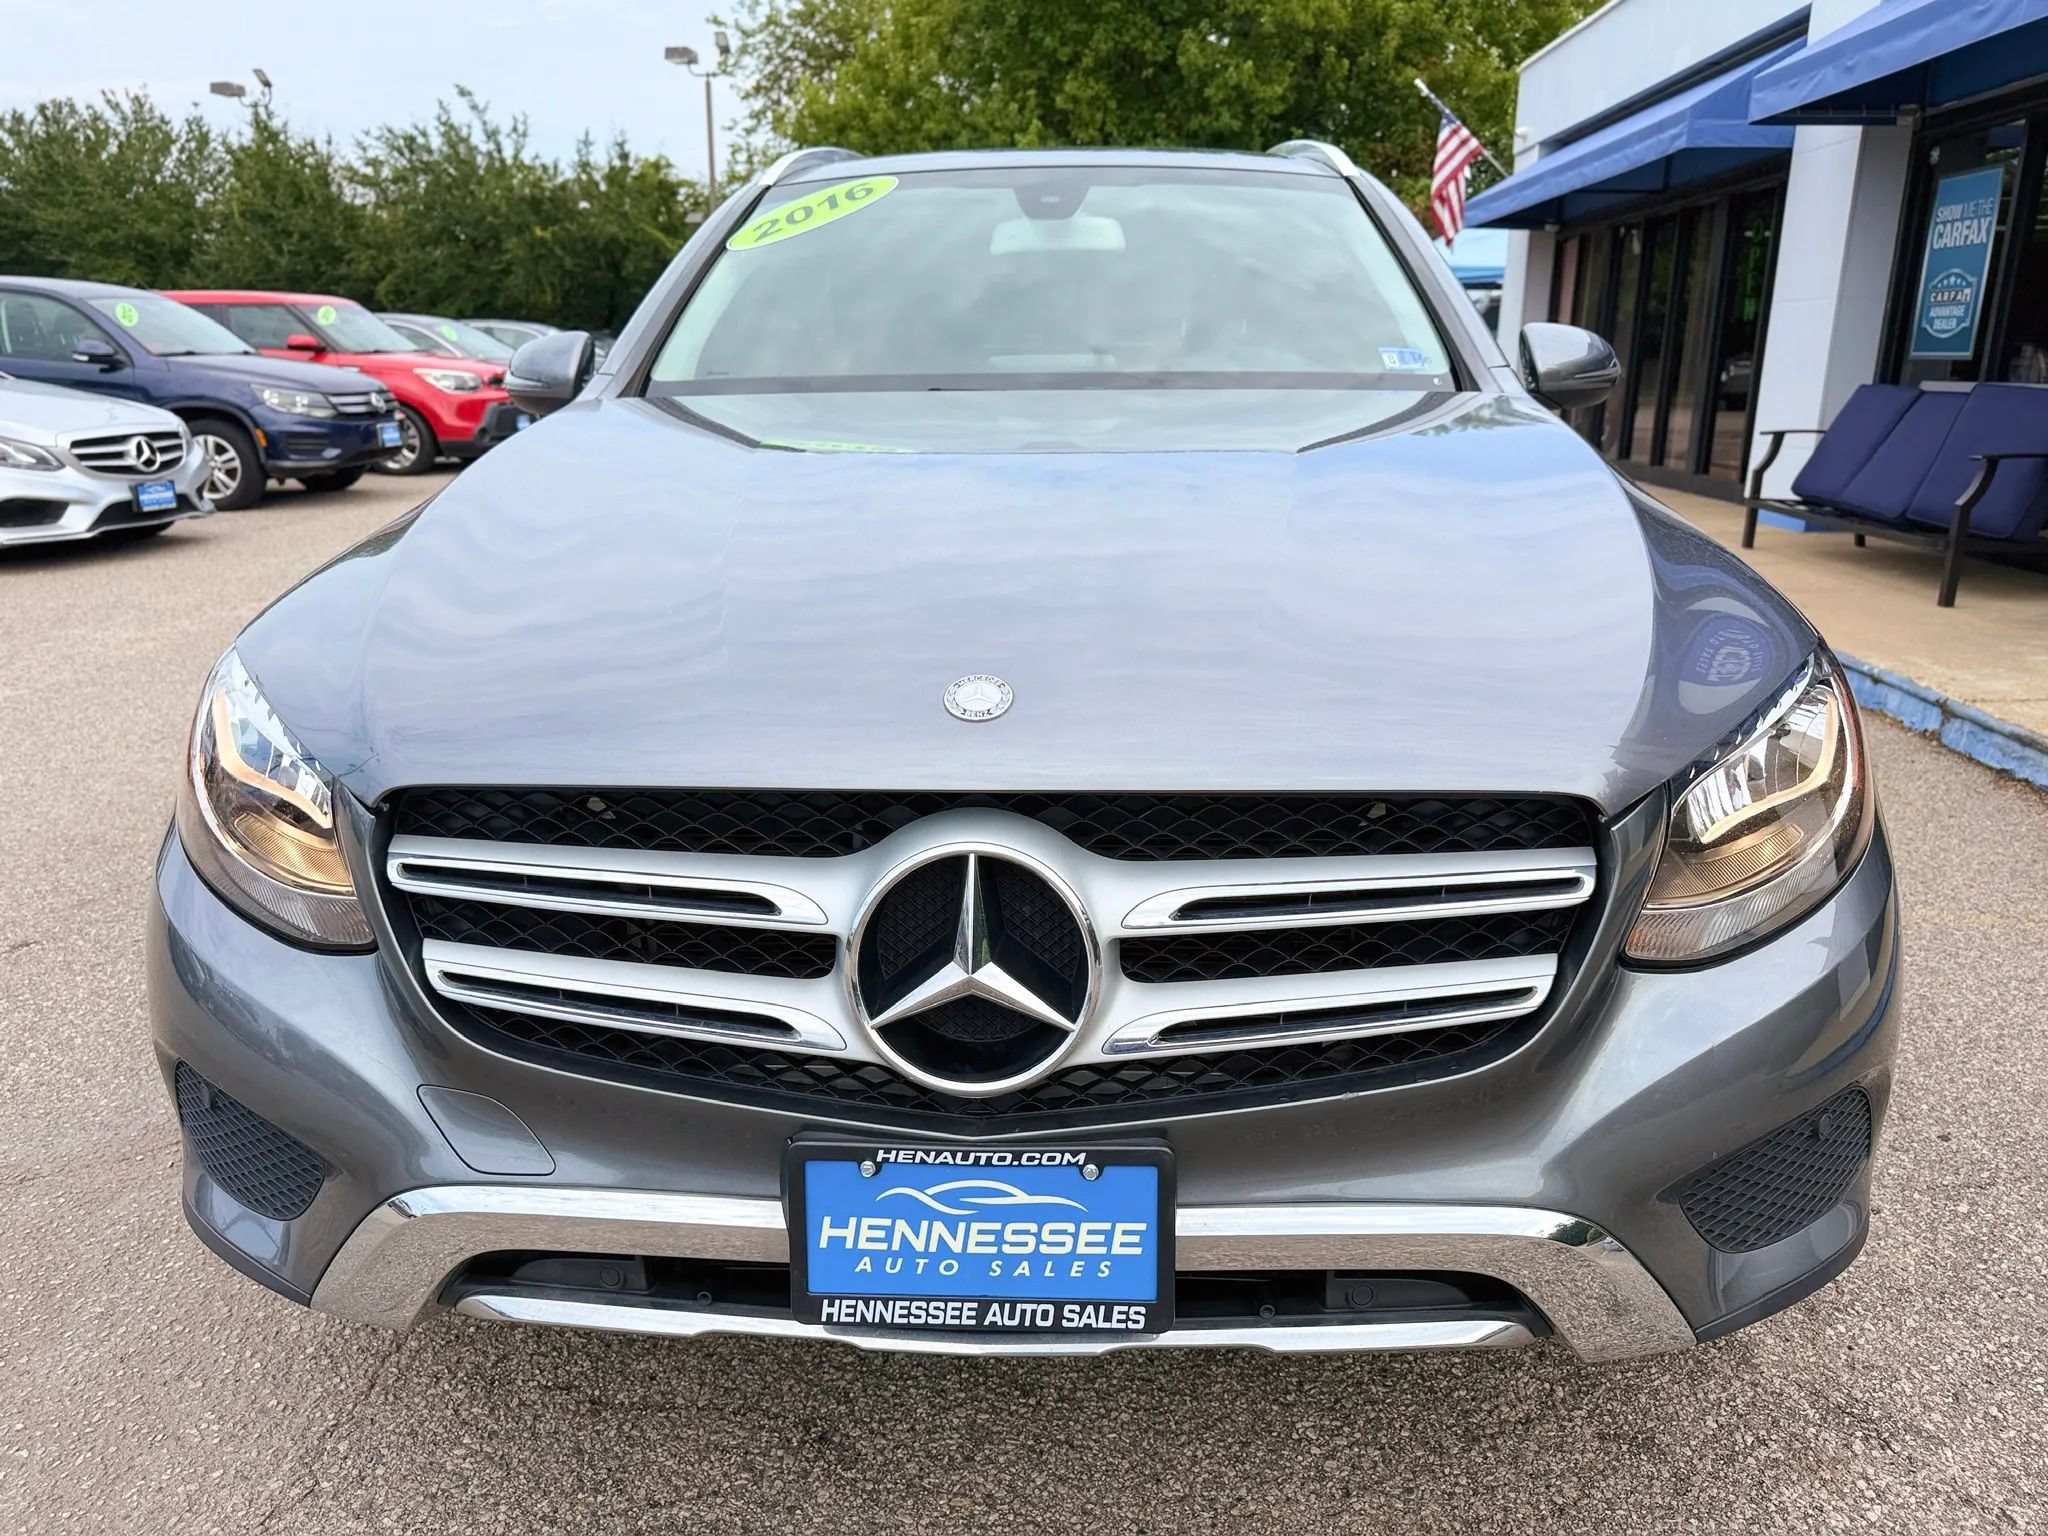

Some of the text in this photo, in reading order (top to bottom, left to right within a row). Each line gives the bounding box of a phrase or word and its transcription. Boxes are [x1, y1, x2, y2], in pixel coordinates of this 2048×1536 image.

[753, 183, 874, 243] 2016
[1936, 198, 1994, 222] SHOW ME THE
[1932, 217, 1991, 249] CARFAX
[1929, 305, 1965, 317] ADVANTAGE
[1933, 318, 1957, 330] DEALER
[876, 1149, 1086, 1166] HENAUTO.COM
[819, 1216, 1148, 1255] HENNESSEE
[854, 1256, 1112, 1278] AUTO SALES
[820, 1299, 1146, 1330] HENNESSEE AUTO SALES
